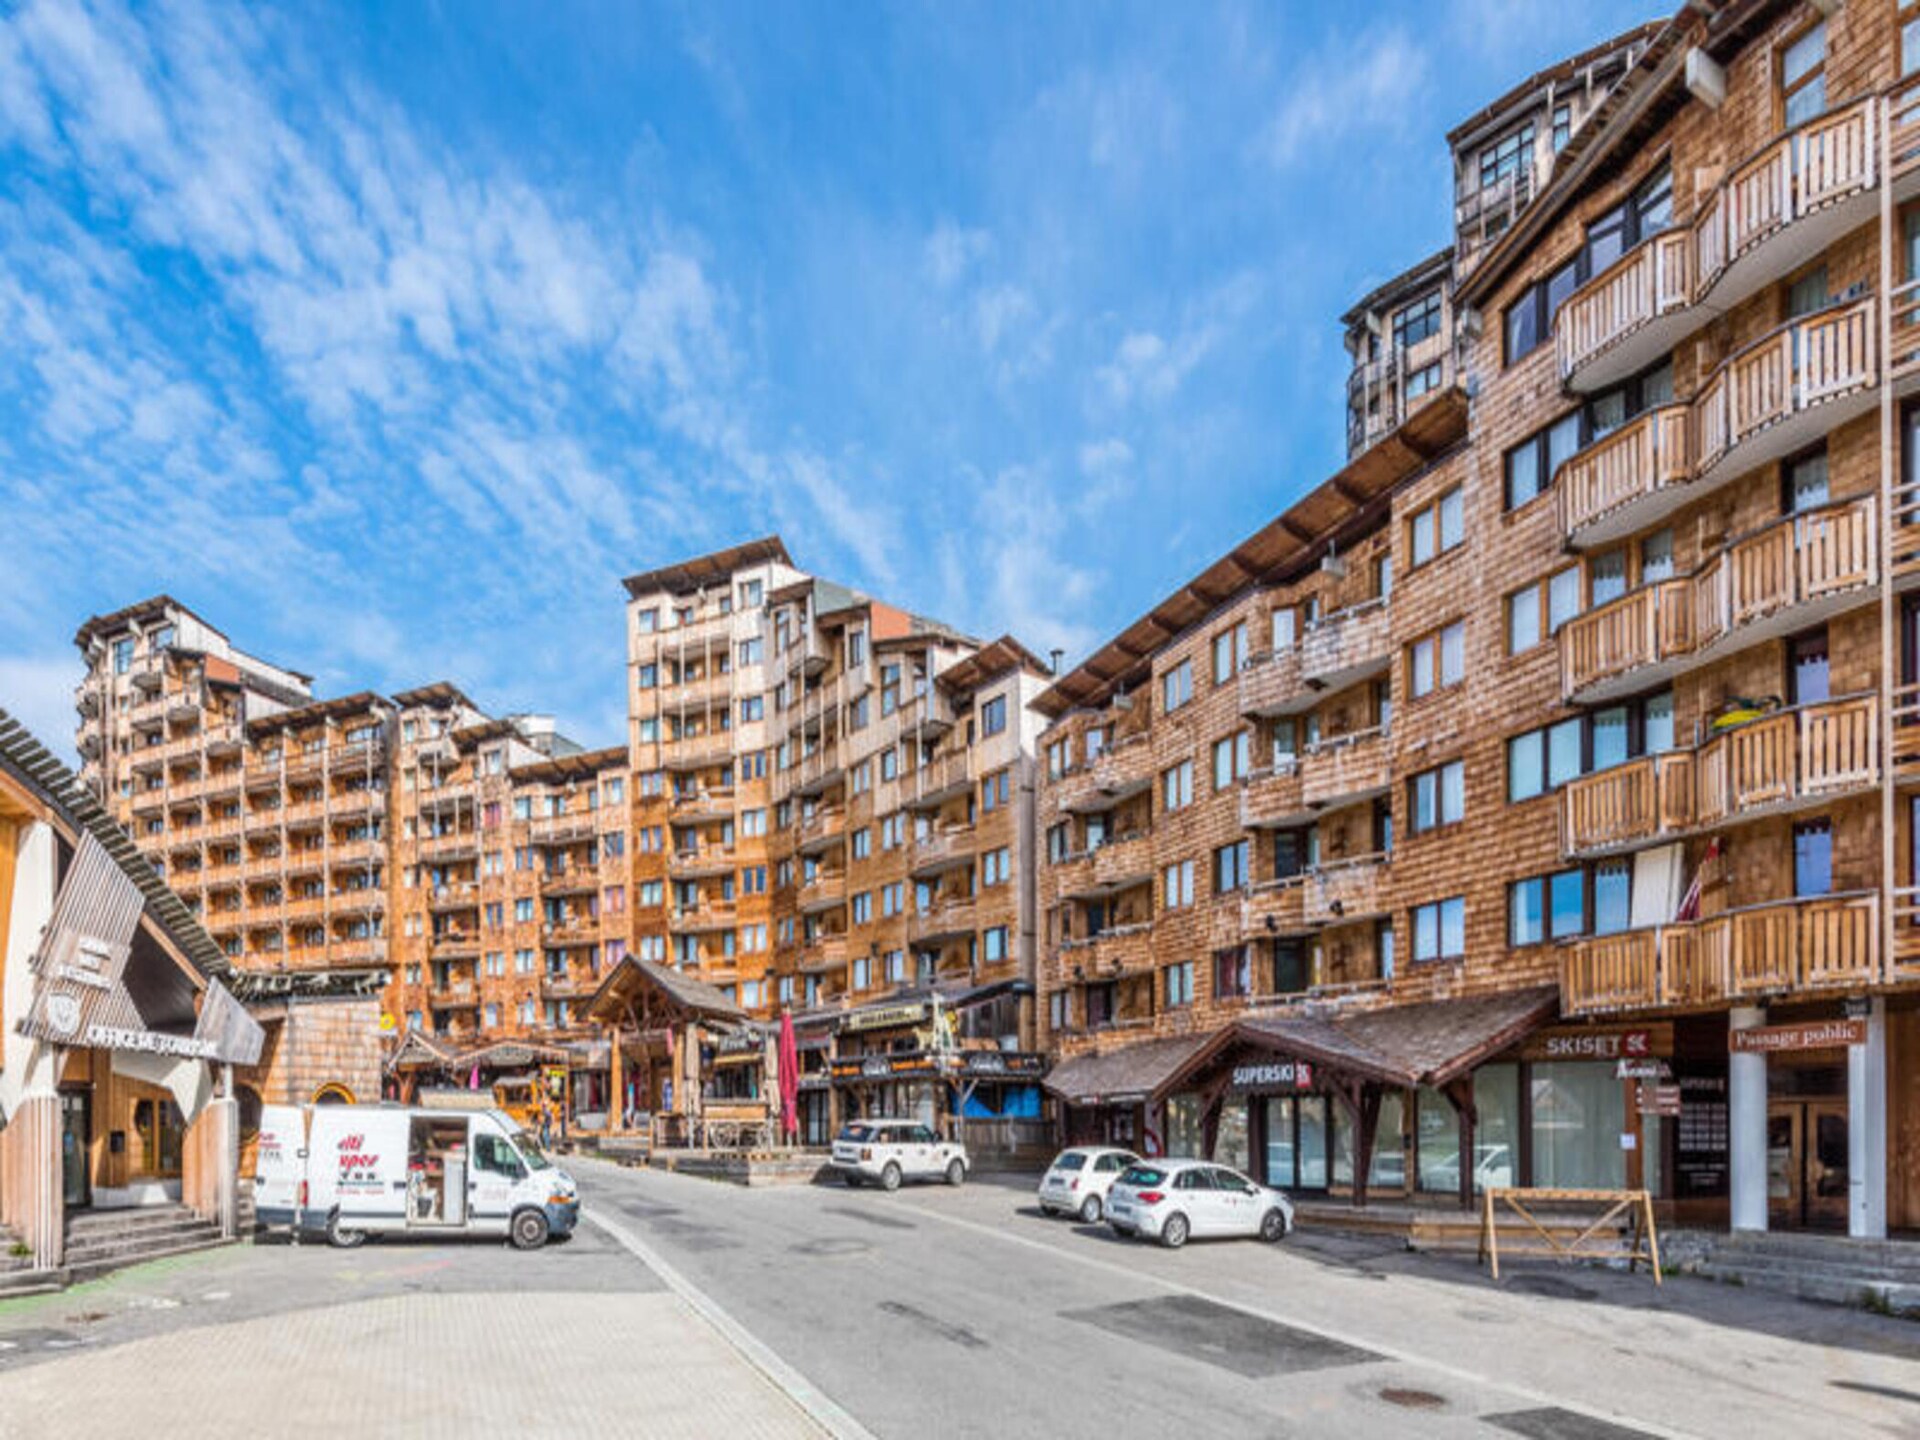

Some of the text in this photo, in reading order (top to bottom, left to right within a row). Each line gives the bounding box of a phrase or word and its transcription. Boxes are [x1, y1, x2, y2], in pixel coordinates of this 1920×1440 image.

[1547, 1035, 1621, 1055] SKISET
[1736, 1024, 1857, 1047] Passage public
[1232, 1064, 1295, 1085] SUPERSKI
